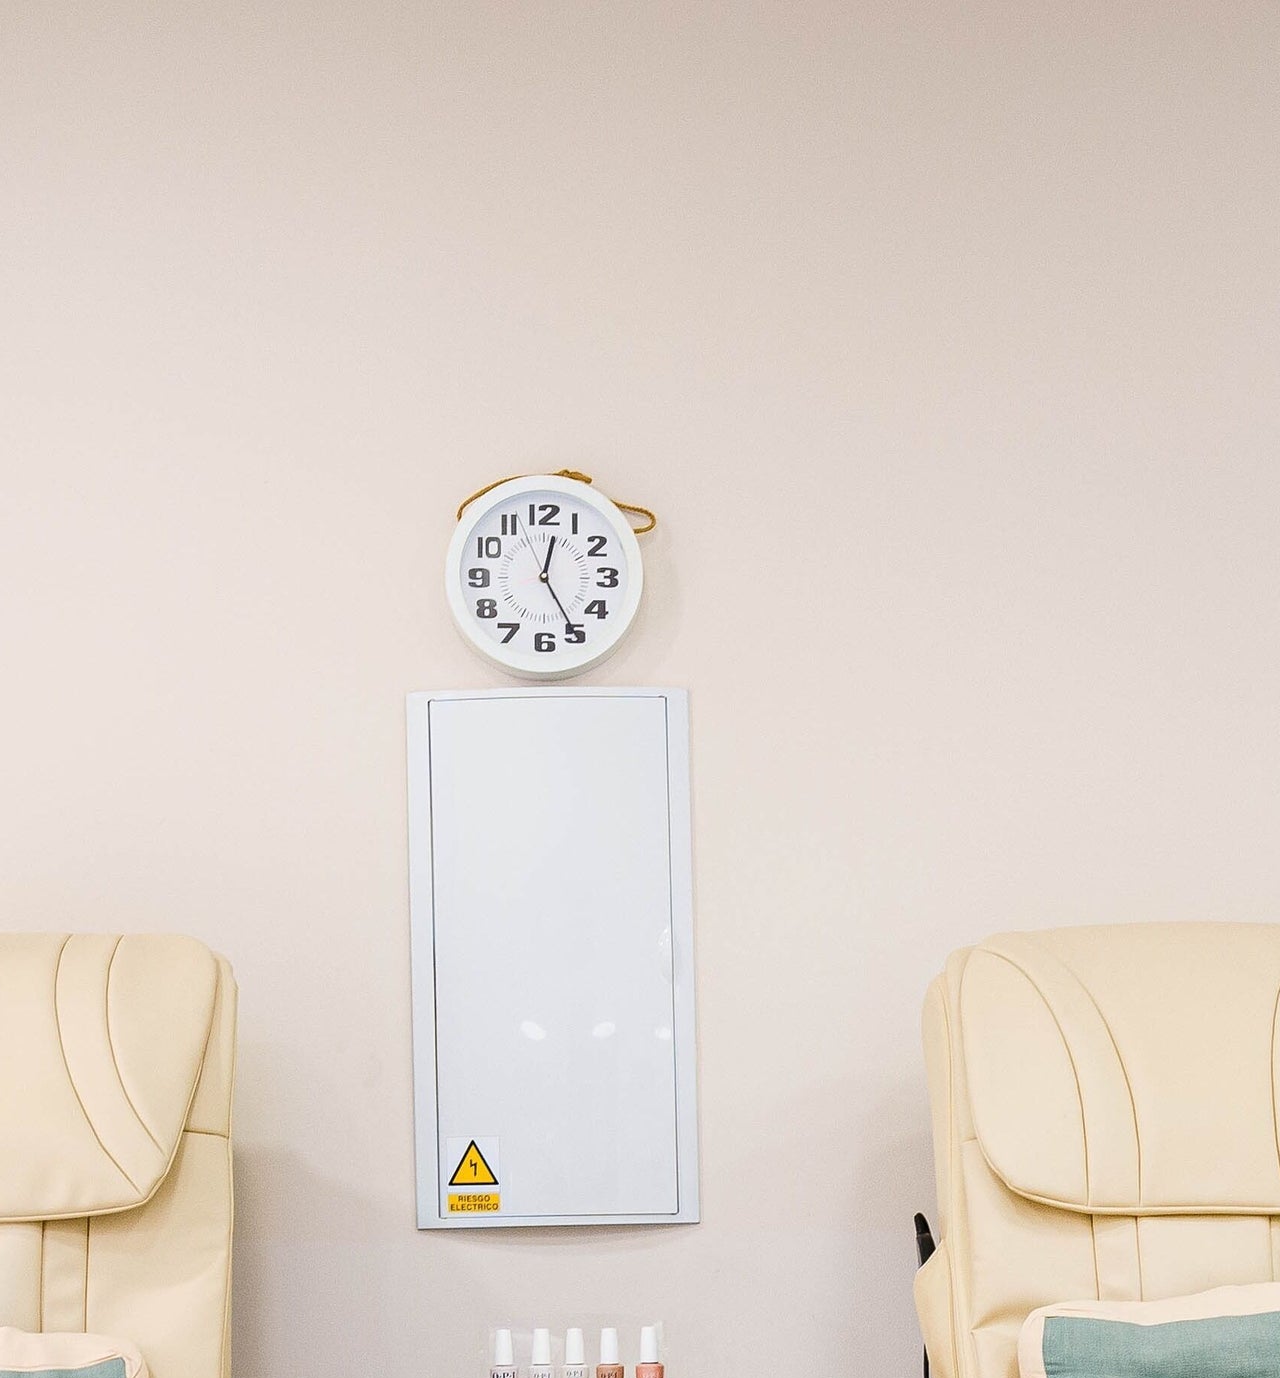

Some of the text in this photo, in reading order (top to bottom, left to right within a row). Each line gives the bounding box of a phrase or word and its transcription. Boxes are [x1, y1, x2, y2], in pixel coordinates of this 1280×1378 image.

[501, 514, 517, 535] 11
[529, 504, 561, 526] 12
[572, 513, 578, 534] 1
[477, 537, 502, 558] 10
[587, 535, 607, 557] 2
[468, 568, 490, 588] 9
[596, 567, 619, 588] 3
[476, 598, 498, 619] 8
[584, 600, 609, 619] 4
[497, 623, 520, 643] 7
[534, 632, 556, 652] 6
[564, 624, 586, 644] 5
[450, 1203, 499, 1212] ELECTRICO
